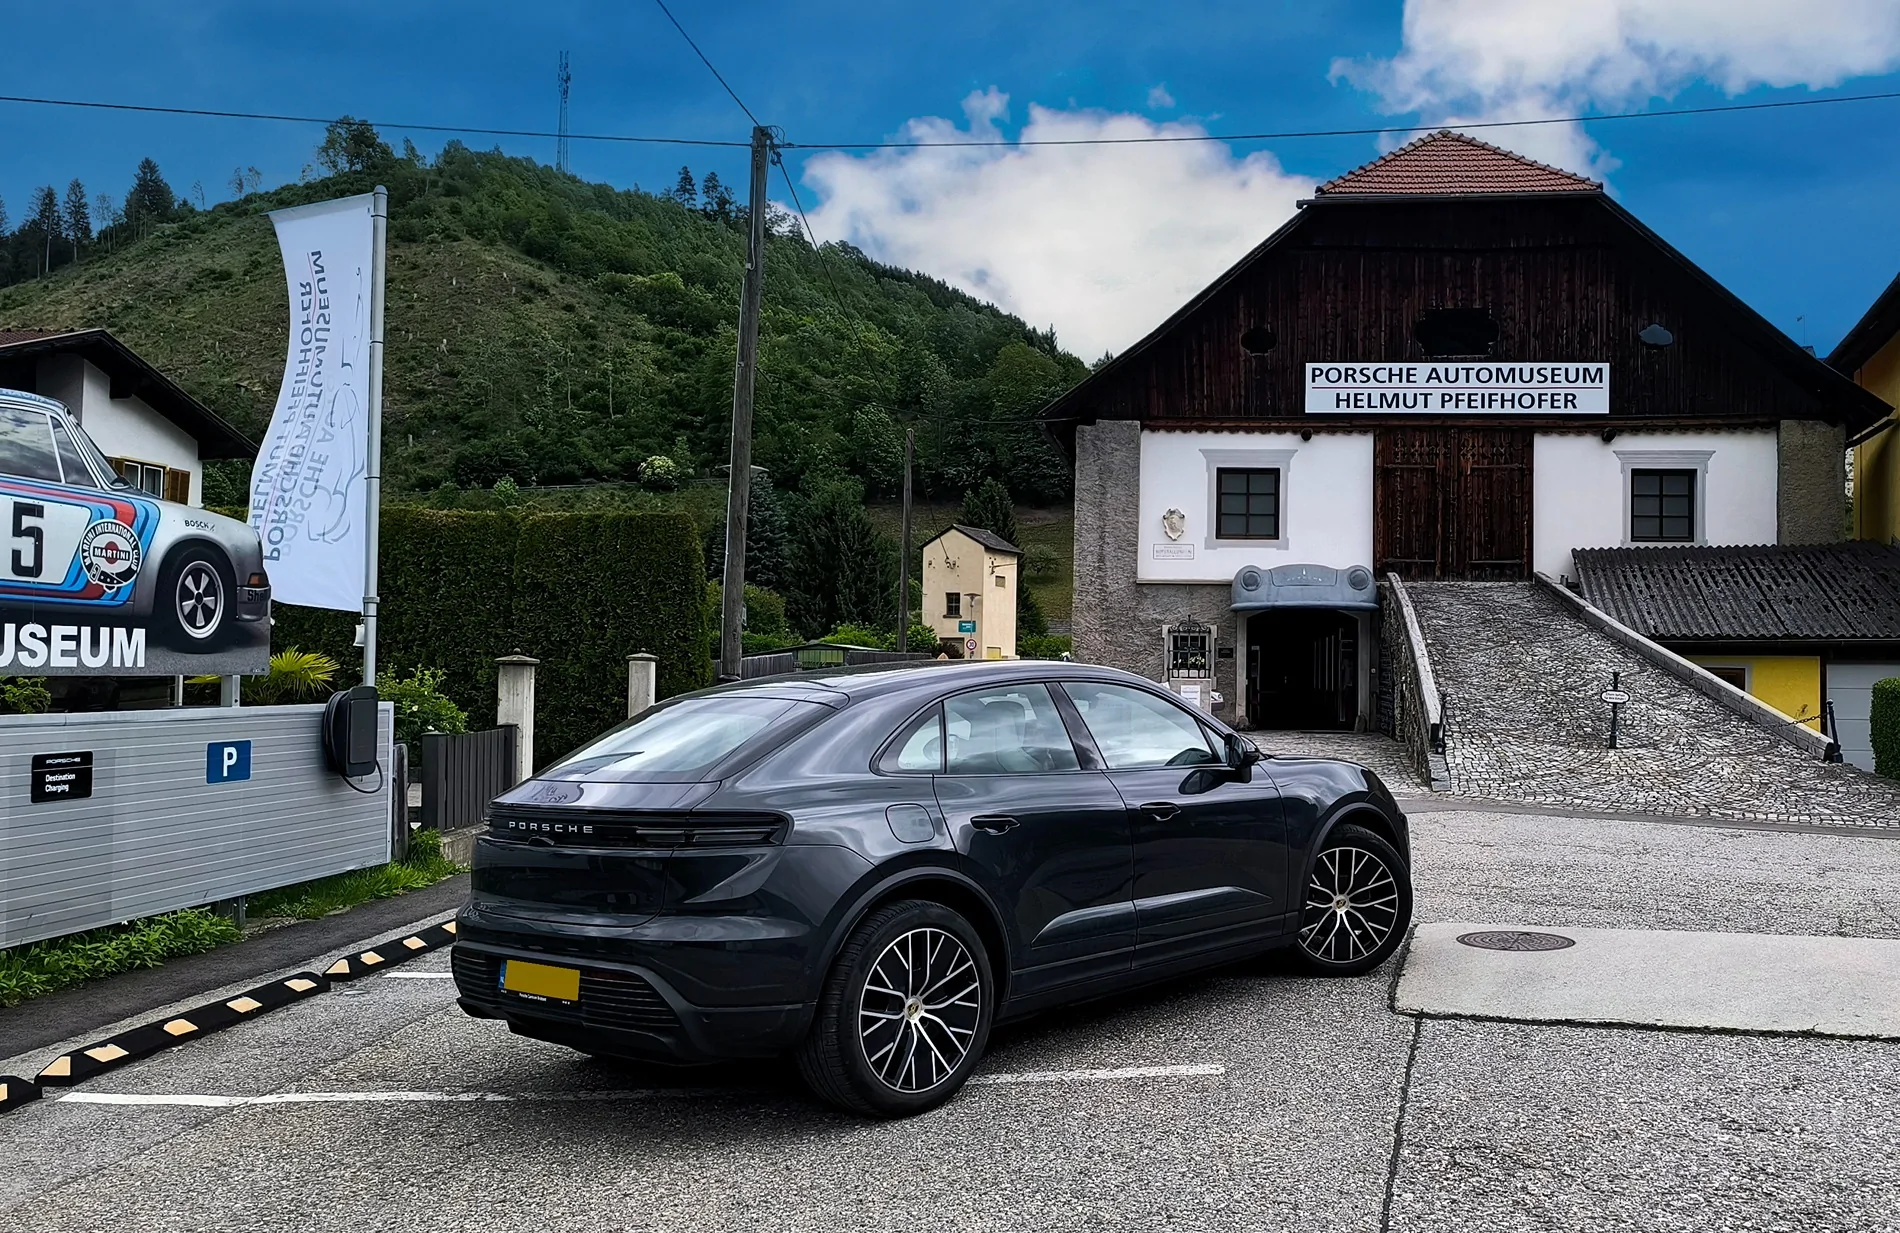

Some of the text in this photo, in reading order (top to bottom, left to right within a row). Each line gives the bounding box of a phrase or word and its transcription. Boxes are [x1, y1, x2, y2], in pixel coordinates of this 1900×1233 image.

[1311, 367, 1604, 384] PORSCHE AUTOMUSEUM
[1335, 392, 1578, 409] HELMUT PFEIFHOFER
[184, 519, 209, 529] BOSCH
[11, 501, 45, 579] 5
[83, 528, 96, 566] MARTINI
[94, 522, 137, 549] INTERNATIONAL
[94, 547, 129, 560] MARTINI
[223, 747, 237, 777] P
[45, 773, 76, 782] Destination
[45, 783, 69, 793] Charging
[509, 821, 593, 834] PORSCHE
